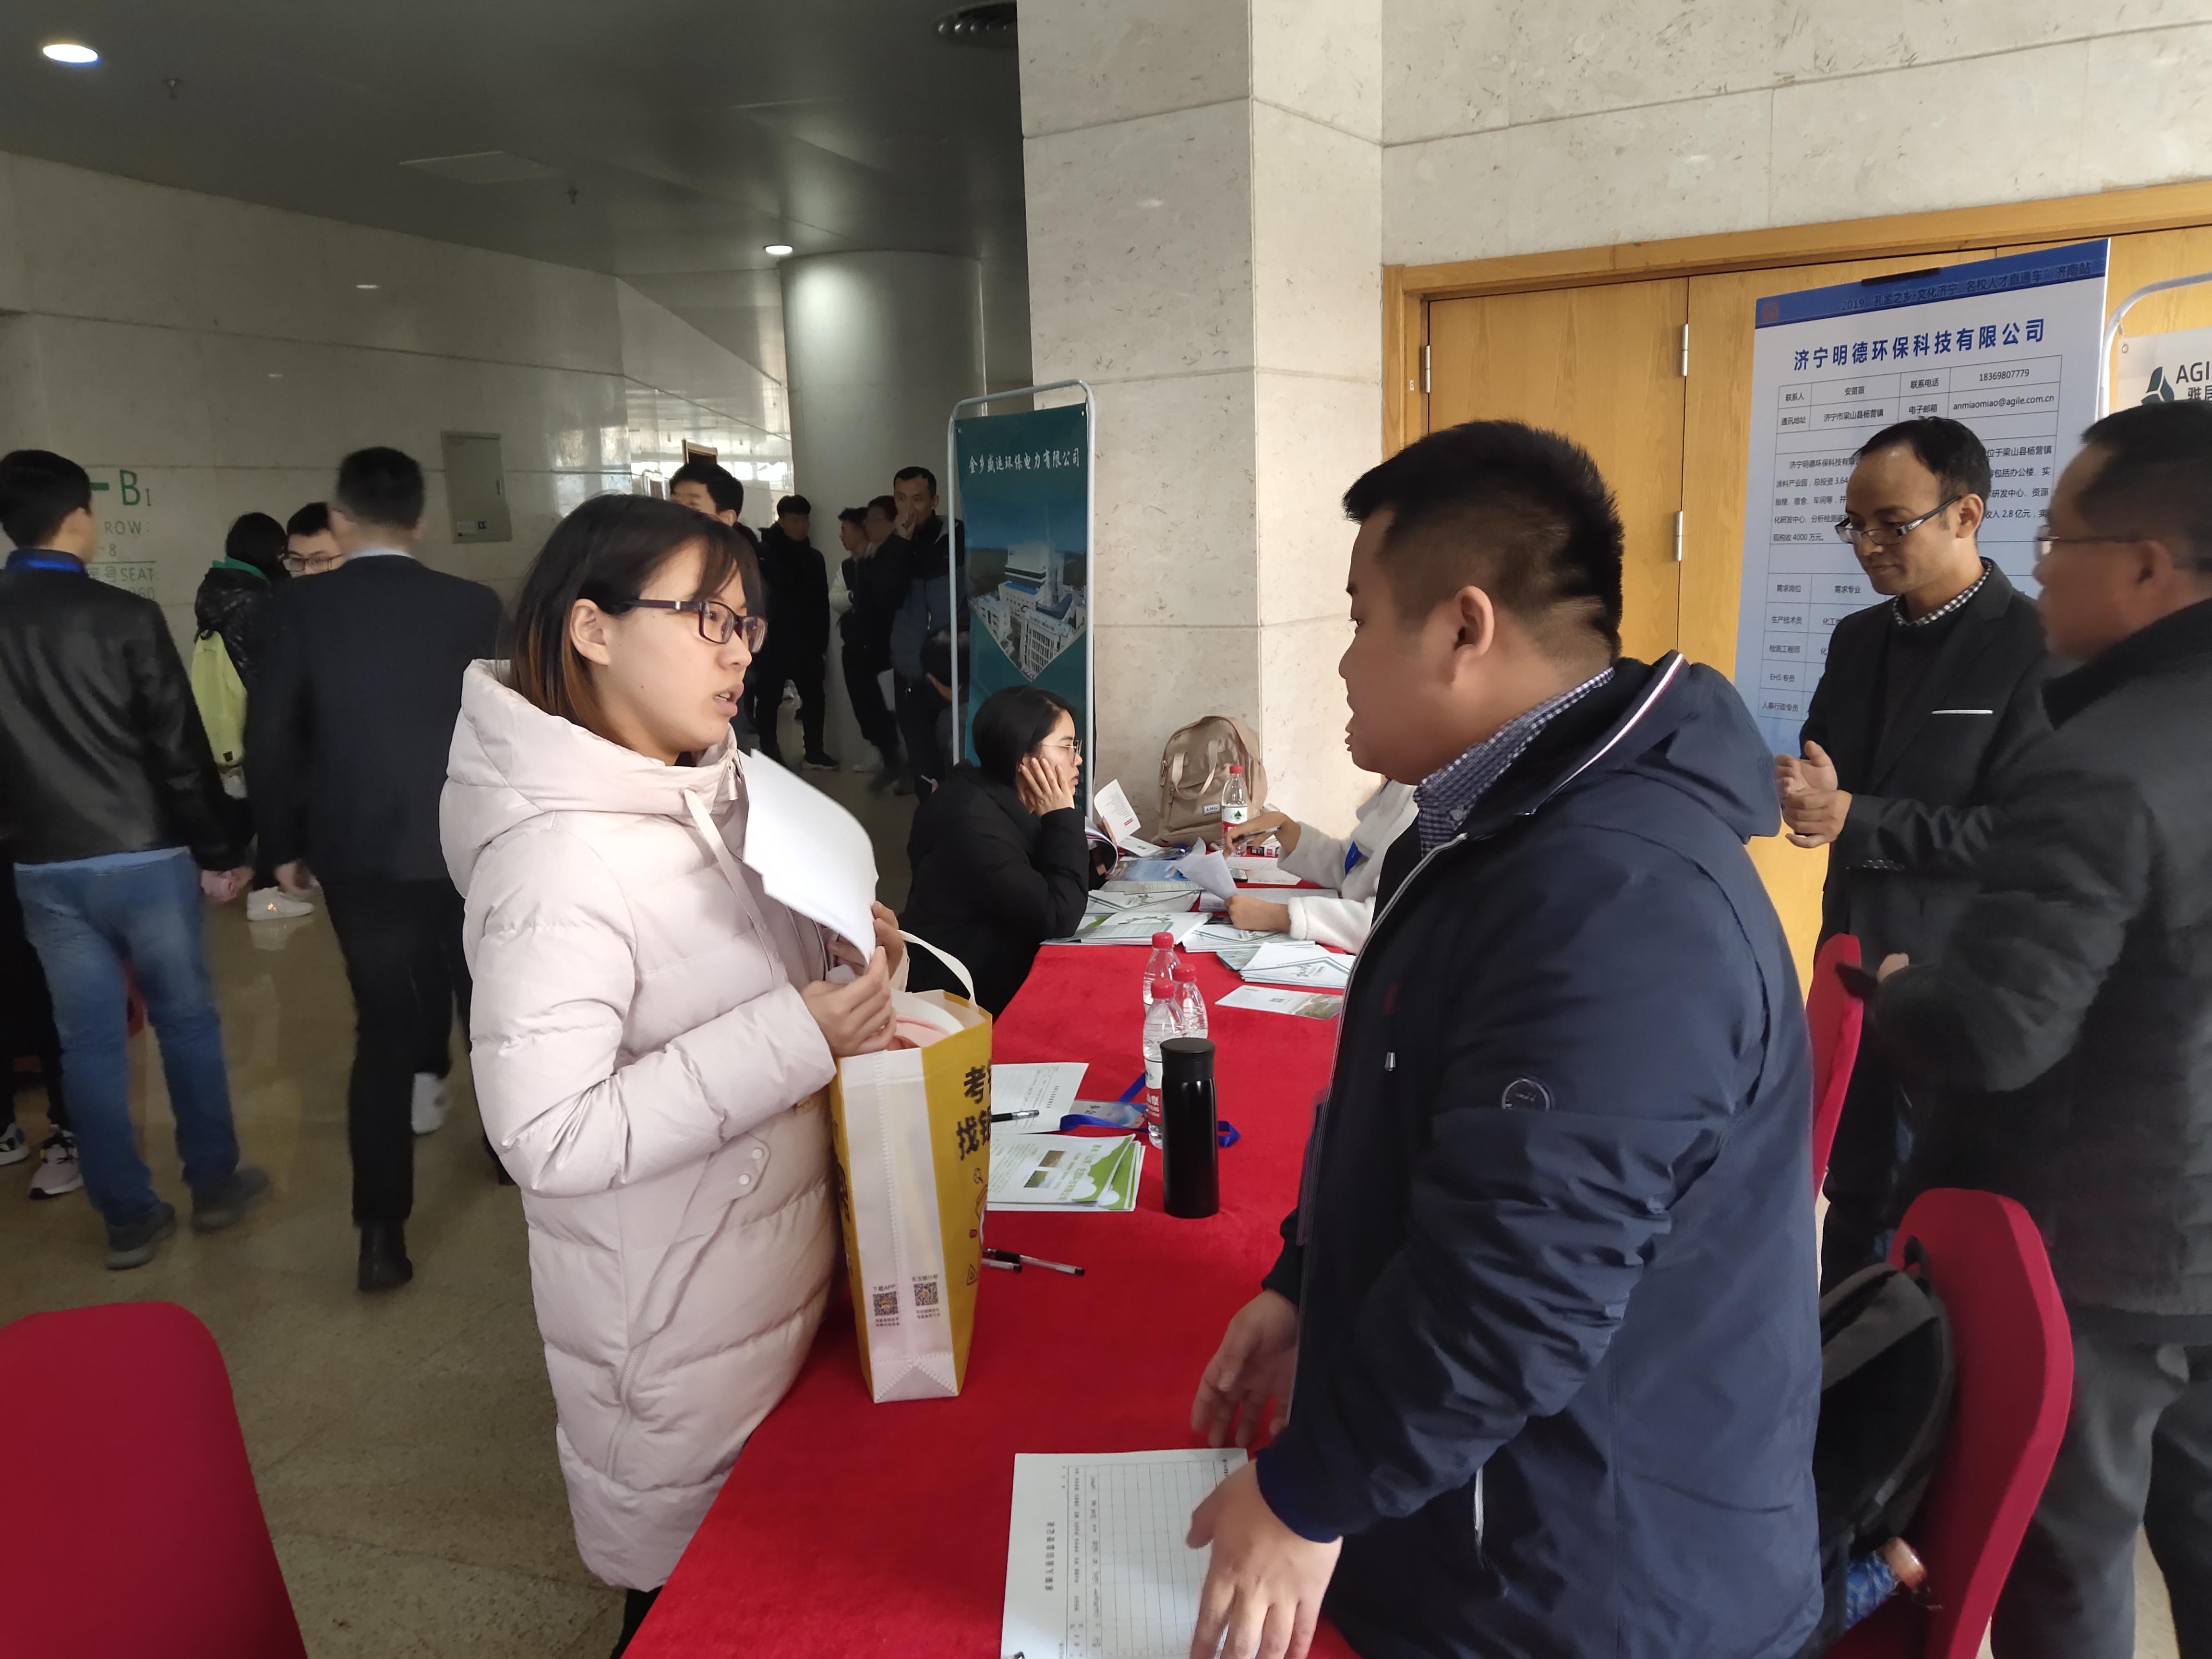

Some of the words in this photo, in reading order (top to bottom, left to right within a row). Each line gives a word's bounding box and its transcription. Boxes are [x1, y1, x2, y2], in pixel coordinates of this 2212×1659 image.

[1794, 319, 2044, 371] 济宁明德环保科技有限公司
[1979, 369, 2030, 381] 18369807779
[1911, 378, 1939, 388] 联系电话
[1845, 386, 1865, 396] 安苗苗
[1785, 393, 1804, 402] 联系人
[1953, 395, 2054, 410] anmiaomiao@agile.com.cn
[1909, 404, 1938, 414] 电子邮箱
[1824, 409, 1884, 422] 济宁市梁山县杨营镇
[1781, 417, 1806, 426] 通讯地址
[1991, 467, 2051, 478] 包括办公楼、实
[1990, 488, 2049, 498] 研发中心、资源
[1777, 585, 1801, 593] 需求岗位
[1835, 586, 1861, 594] 需求专业
[1771, 616, 1802, 625] 生产技术员
[1769, 645, 1800, 654] 检测工程师
[1762, 702, 1798, 712] 人事行政专员
